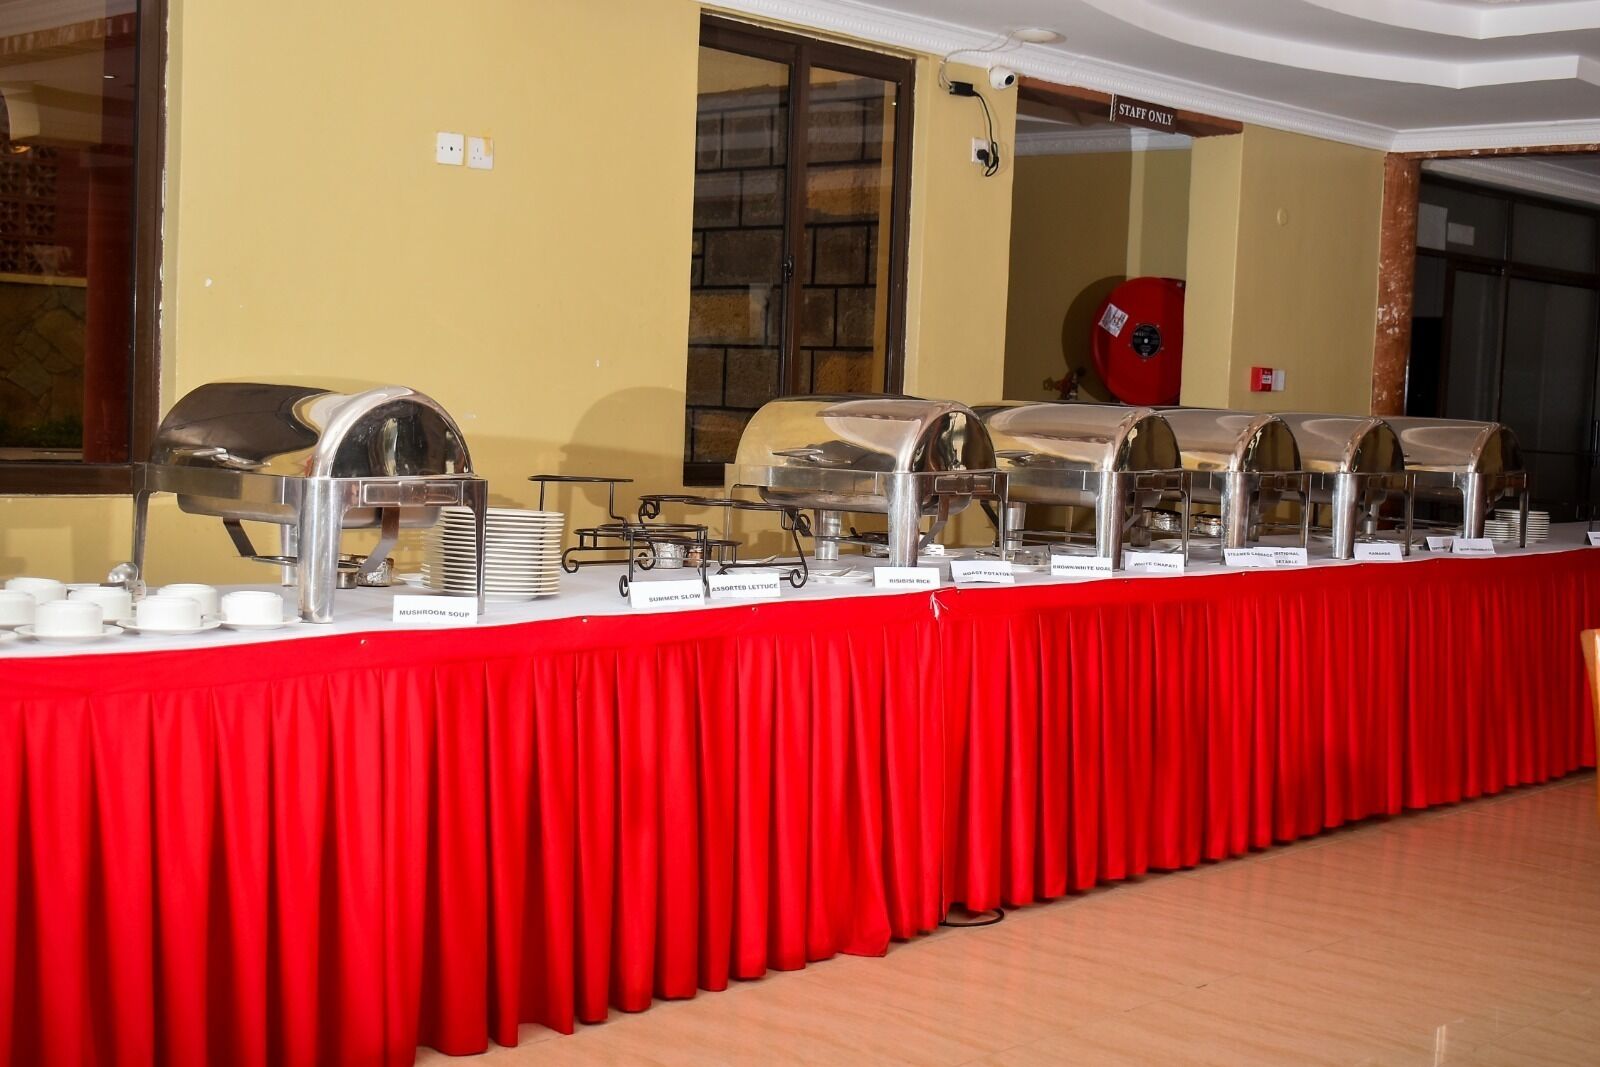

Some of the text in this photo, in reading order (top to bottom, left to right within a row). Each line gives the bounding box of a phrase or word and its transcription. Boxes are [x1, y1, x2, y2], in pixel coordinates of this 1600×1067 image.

[1119, 103, 1174, 126] STAFF ONLY
[648, 595, 679, 603] SUMMER
